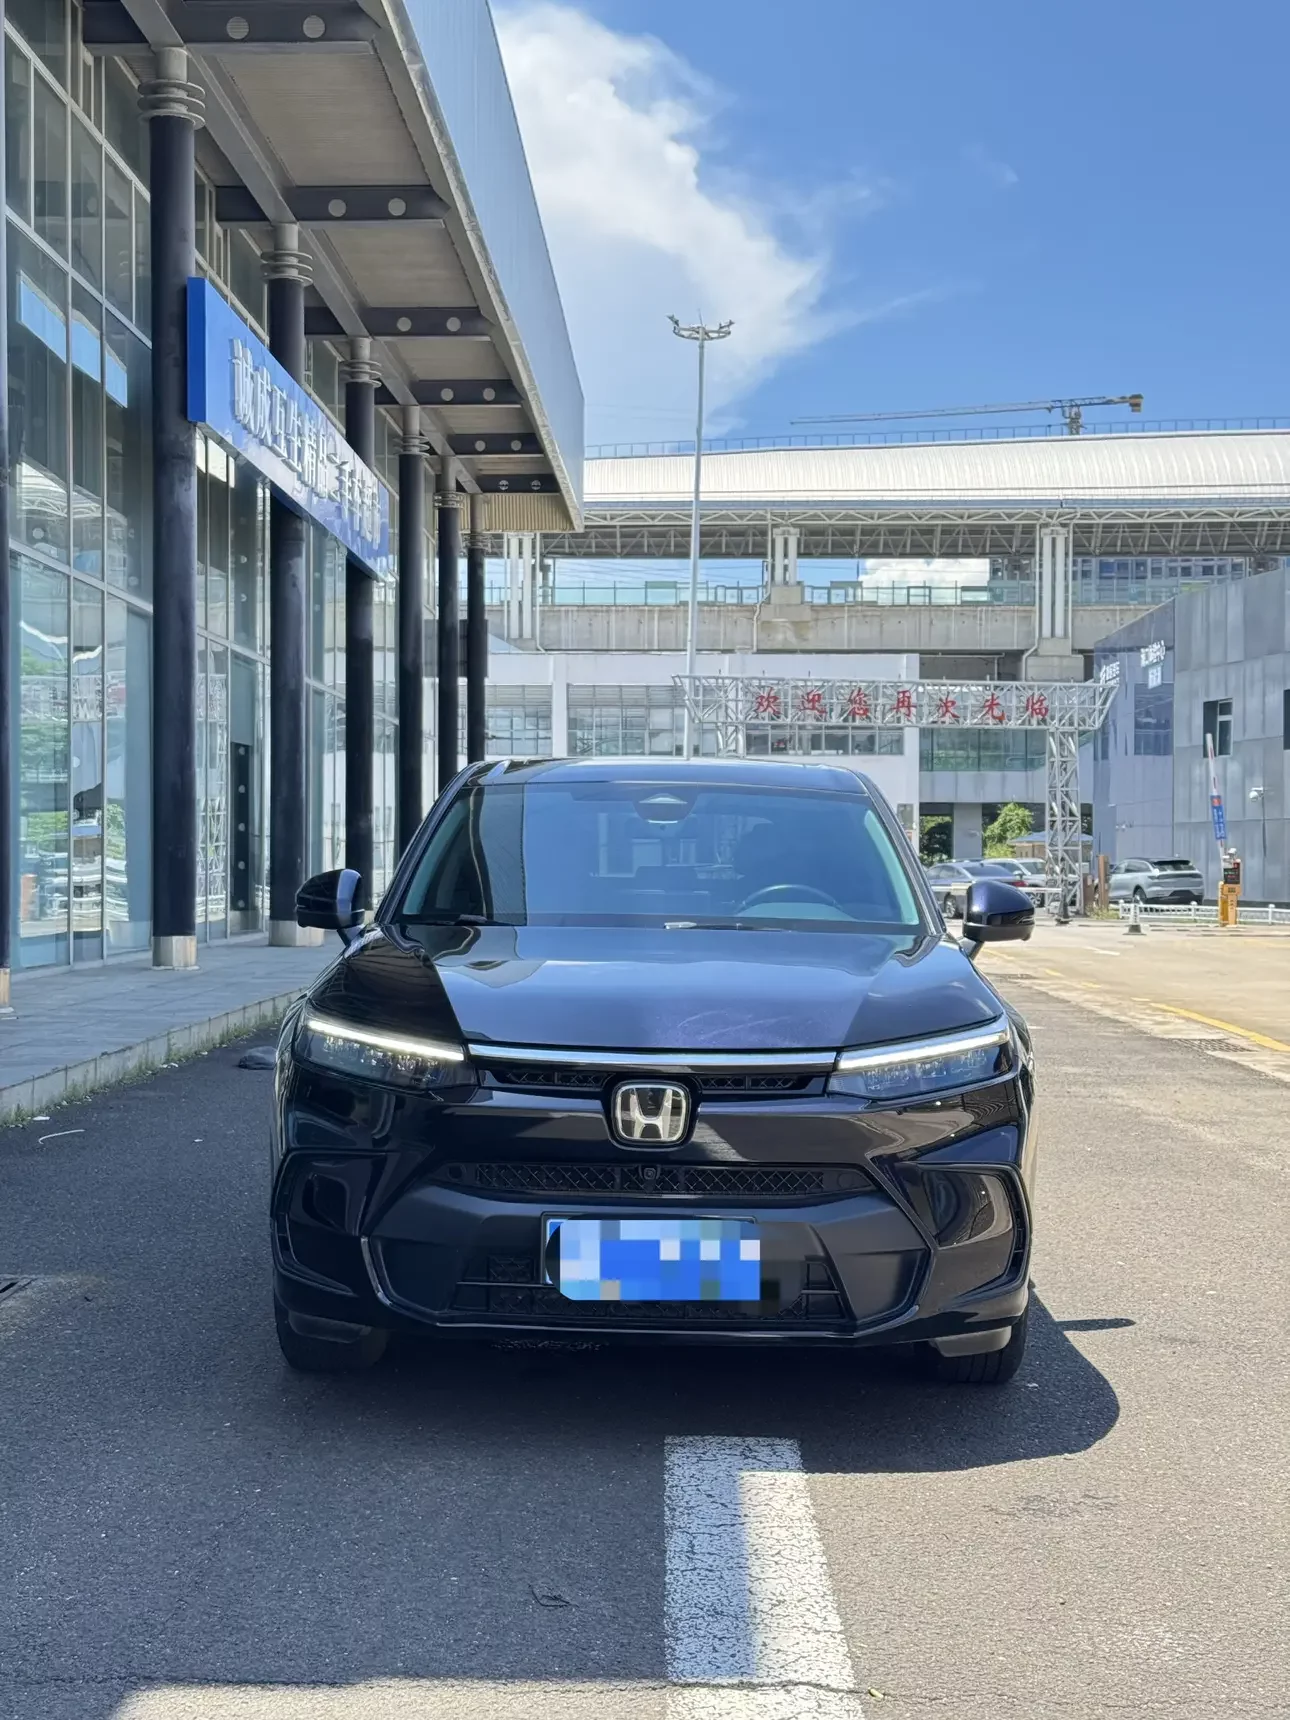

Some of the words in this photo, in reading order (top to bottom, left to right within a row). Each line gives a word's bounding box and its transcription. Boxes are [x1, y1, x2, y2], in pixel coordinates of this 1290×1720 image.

[755, 686, 1049, 720] 欢迎您再次光临
